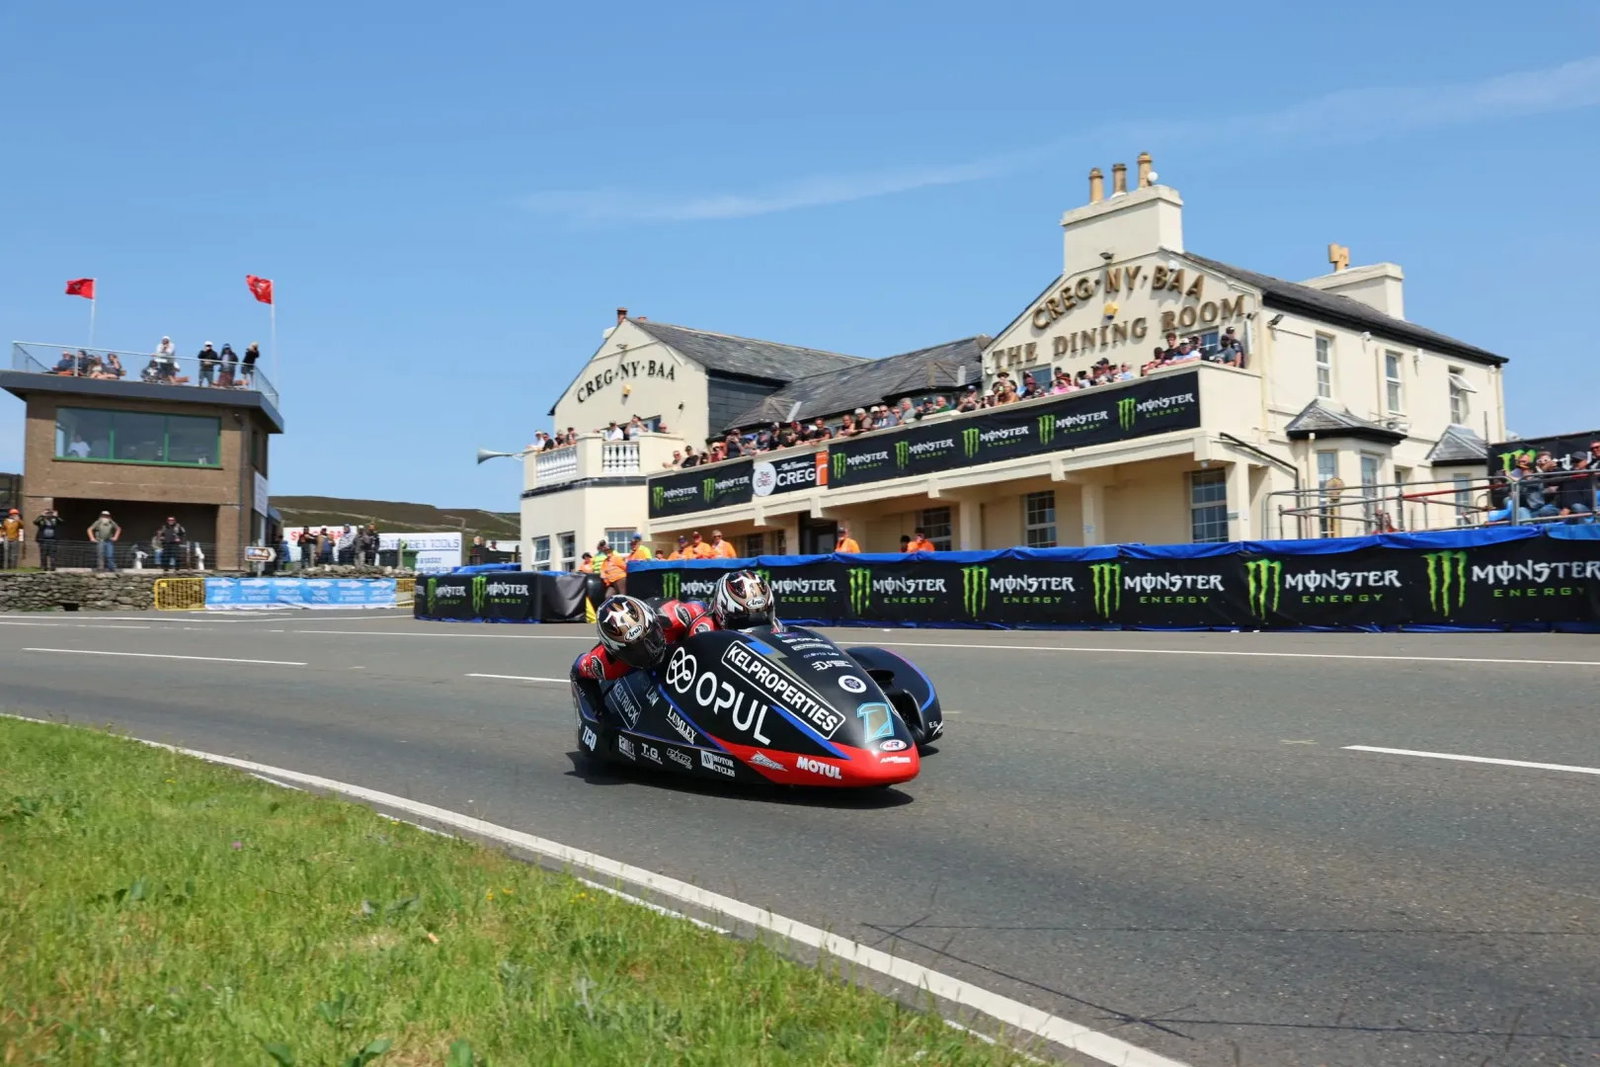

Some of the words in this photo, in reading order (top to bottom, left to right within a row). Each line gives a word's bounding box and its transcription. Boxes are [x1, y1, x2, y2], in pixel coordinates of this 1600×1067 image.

[1032, 277, 1094, 330] CREG
[1105, 266, 1142, 293] NY
[1152, 265, 1206, 300] BAA
[992, 342, 1038, 369] THE
[1054, 317, 1148, 357] DINING
[1161, 294, 1247, 333] ROOM
[577, 369, 613, 403] CREG
[620, 361, 640, 378] NY
[648, 360, 675, 380] BAA
[1136, 393, 1195, 413] MONSTER
[1056, 411, 1109, 429] MONSTER
[1146, 407, 1186, 418] ENERGY
[980, 425, 1030, 443] MONSTER
[908, 438, 955, 455] MONSTER
[847, 451, 889, 467] MONSTER
[776, 468, 816, 486] CREG
[1285, 569, 1402, 592] MONSTER
[1472, 560, 1600, 585] MONSTER
[681, 580, 716, 595] MONS
[771, 577, 837, 594] MONSTER
[873, 577, 947, 594] MONSTER
[990, 574, 1076, 593] MONSTER
[1124, 572, 1225, 593] MONSTER
[750, 598, 765, 606] Arai
[1003, 596, 1062, 604] ENERGY
[1139, 596, 1209, 604] ENERGY
[1301, 594, 1384, 604] ENERGY
[626, 625, 642, 640] Arai
[727, 646, 838, 732] KELPROPERTIES
[612, 681, 640, 724] KELTRUCK
[695, 671, 771, 746] OPUL
[667, 704, 698, 741] LUMLEY
[857, 702, 895, 743] 1
[713, 755, 734, 768] MOTOR
[796, 755, 842, 780] MOTUL
[713, 765, 735, 778] CYCLES
